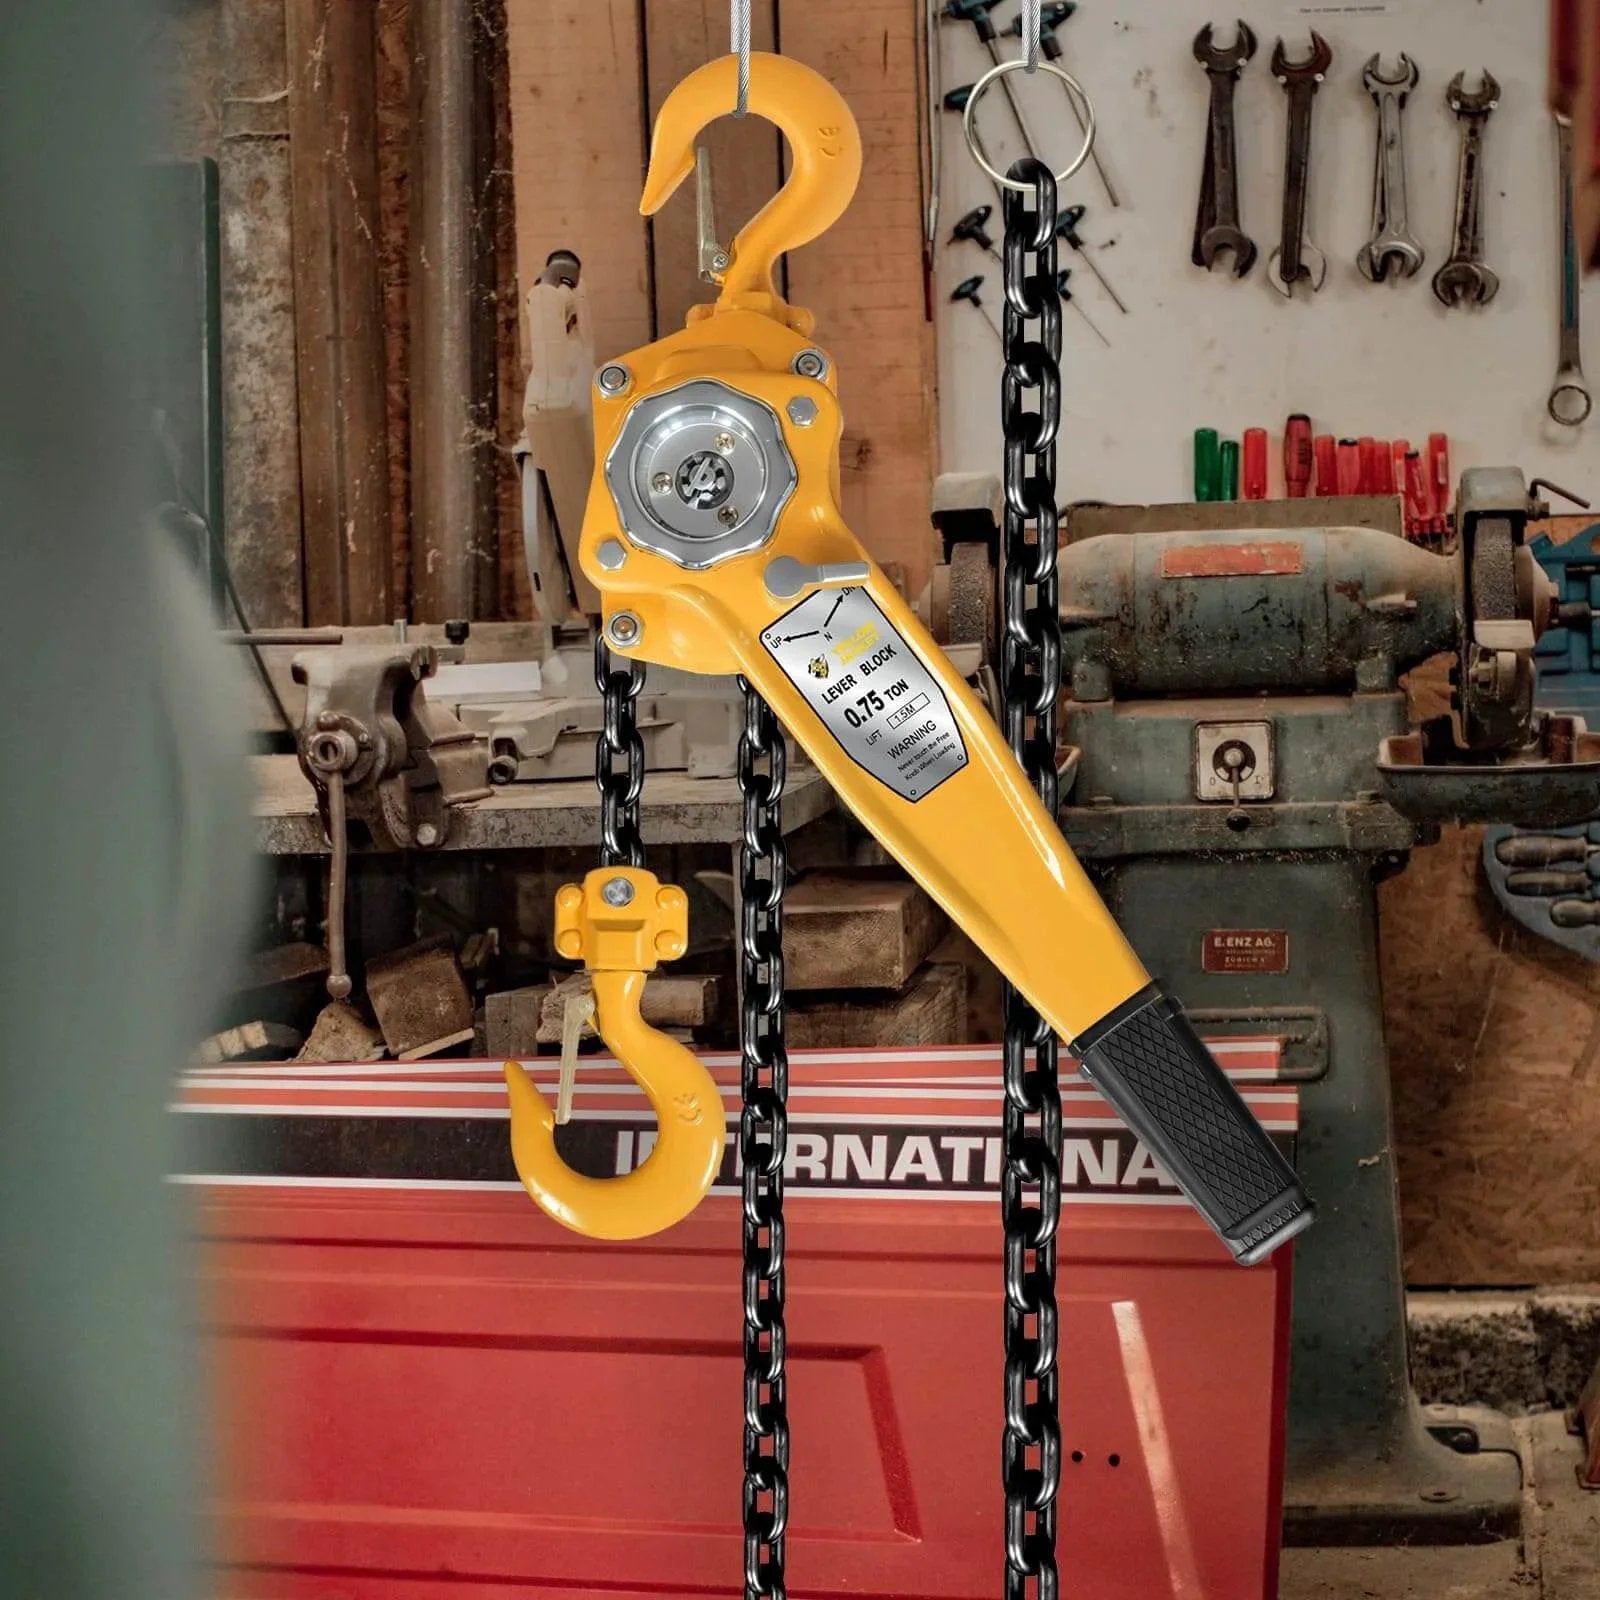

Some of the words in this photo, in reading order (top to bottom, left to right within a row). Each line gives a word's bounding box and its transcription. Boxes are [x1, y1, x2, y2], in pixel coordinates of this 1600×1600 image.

[770, 636, 783, 650] UP
[824, 632, 833, 643] N
[821, 673, 858, 705] LEVER
[859, 644, 897, 676] BLOCK
[843, 689, 886, 729] 0.75
[884, 678, 910, 702] TON
[866, 728, 883, 746] LIFT
[894, 704, 915, 723] 1.5M
[887, 719, 937, 760] WARNING
[897, 757, 913, 772] Never
[935, 731, 949, 743] Free
